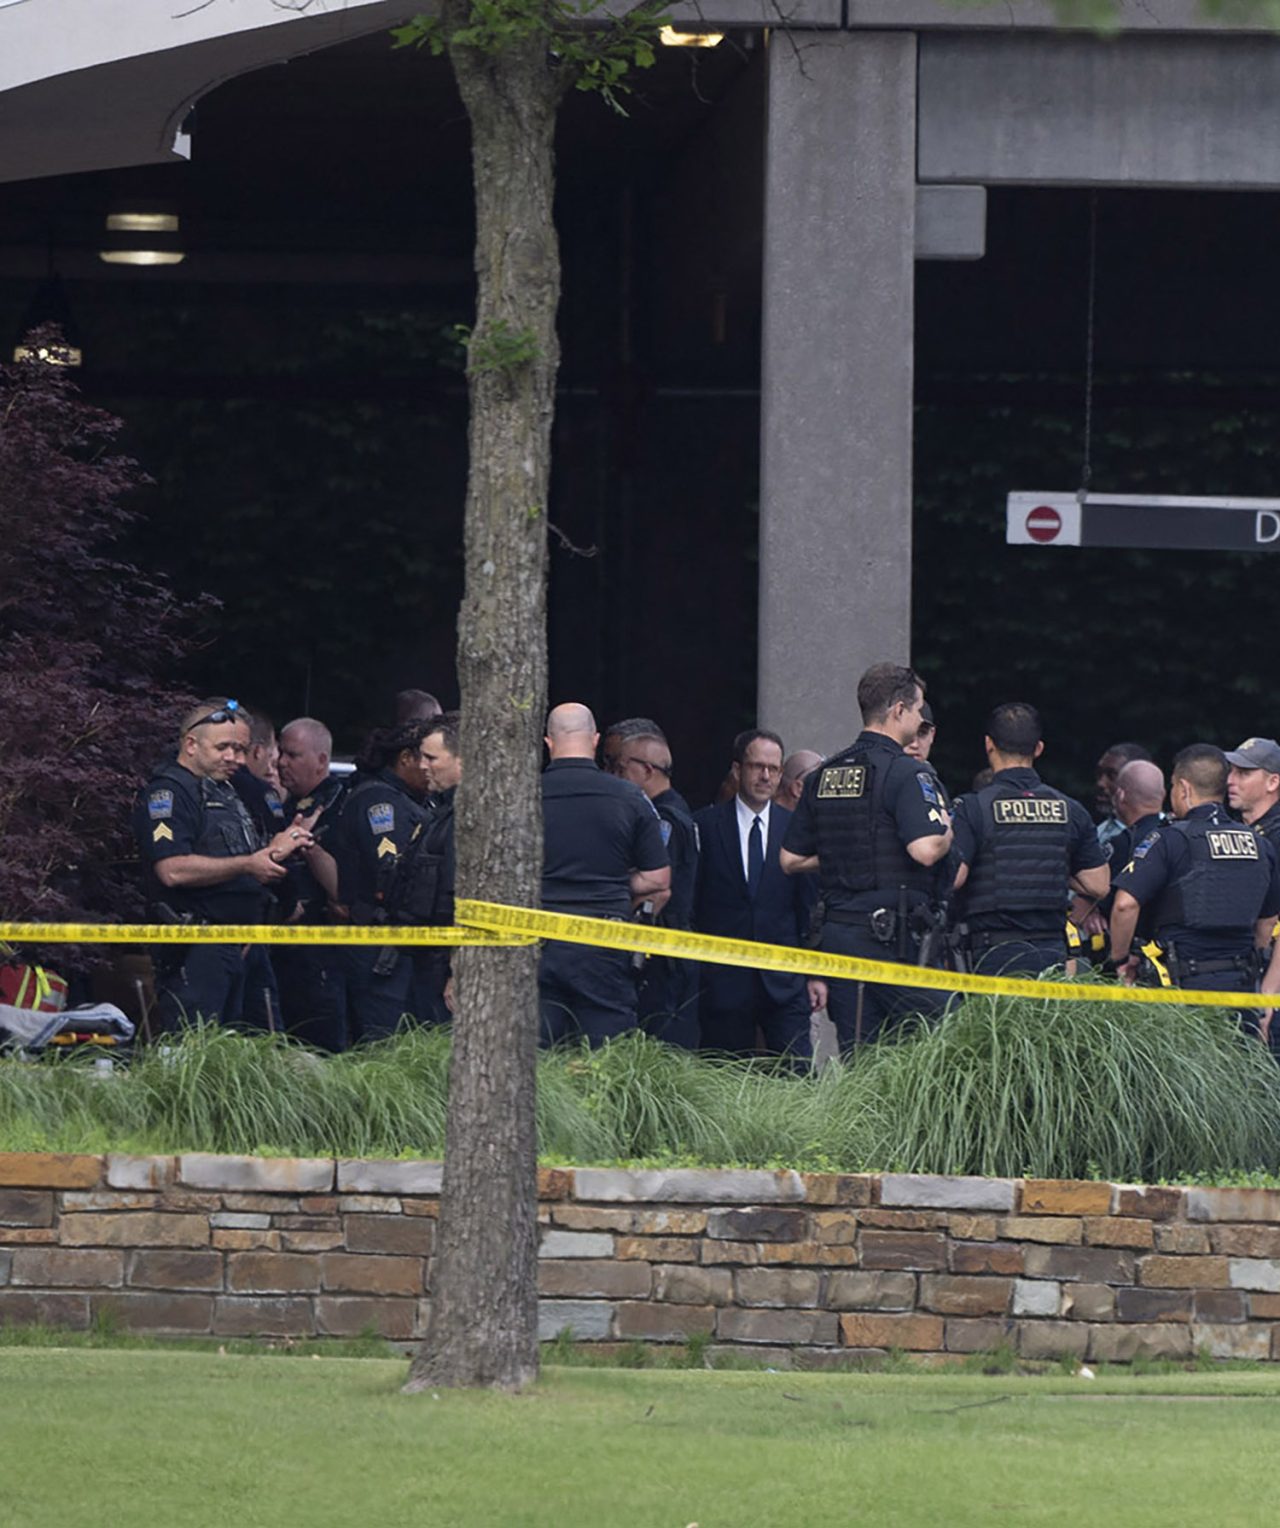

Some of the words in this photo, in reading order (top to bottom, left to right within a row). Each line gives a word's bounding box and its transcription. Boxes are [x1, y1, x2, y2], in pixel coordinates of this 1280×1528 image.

[824, 769, 862, 789] POLICE
[1001, 801, 1062, 817] POLICE
[1210, 833, 1257, 855] POLICE
